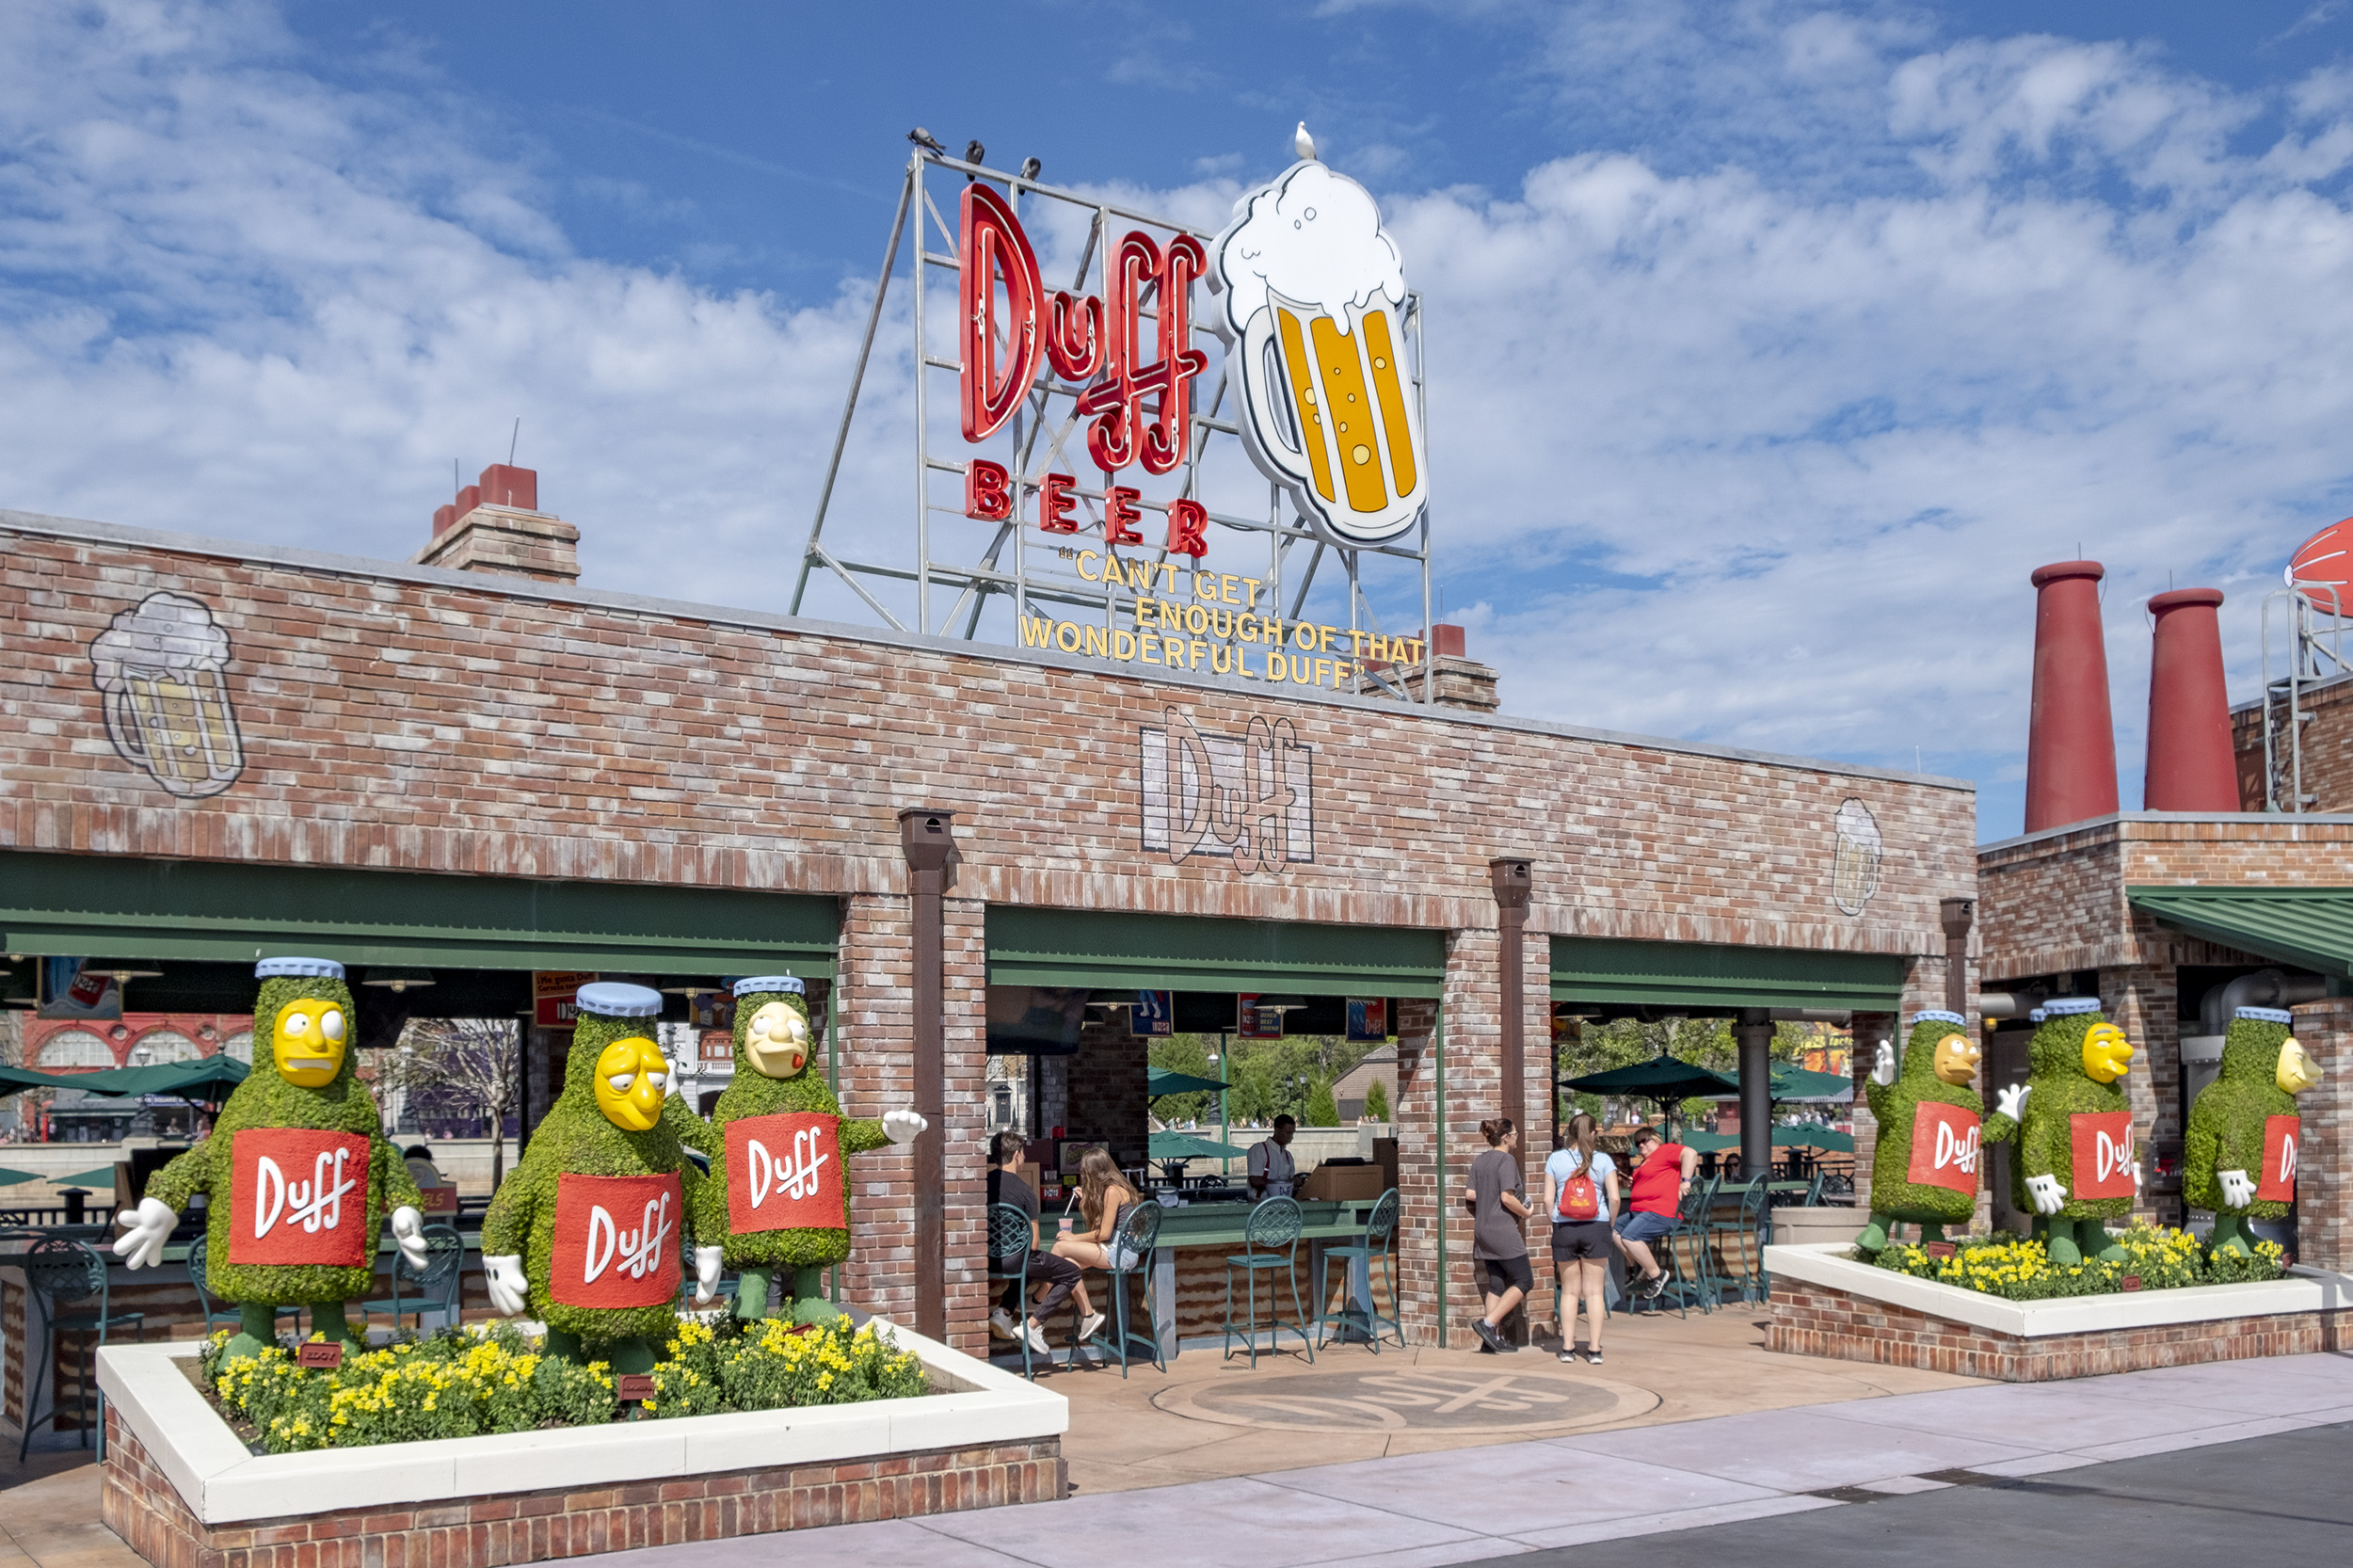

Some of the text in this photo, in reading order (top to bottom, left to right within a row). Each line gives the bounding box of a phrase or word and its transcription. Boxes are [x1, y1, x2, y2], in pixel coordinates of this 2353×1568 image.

[960, 182, 1209, 475] Duff
[966, 458, 1209, 558] BEER
[1135, 595, 1425, 666] ENOUGH OF THAT
[1194, 569, 1261, 608] GET
[1020, 614, 1254, 678] WONDERFUL
[1164, 705, 1297, 876] Duff
[747, 1125, 829, 1209] Duff
[1934, 1120, 1980, 1175] Duff
[255, 1146, 357, 1239] Duff
[584, 1191, 672, 1284] Duff
[1218, 1369, 1570, 1431] Duff
